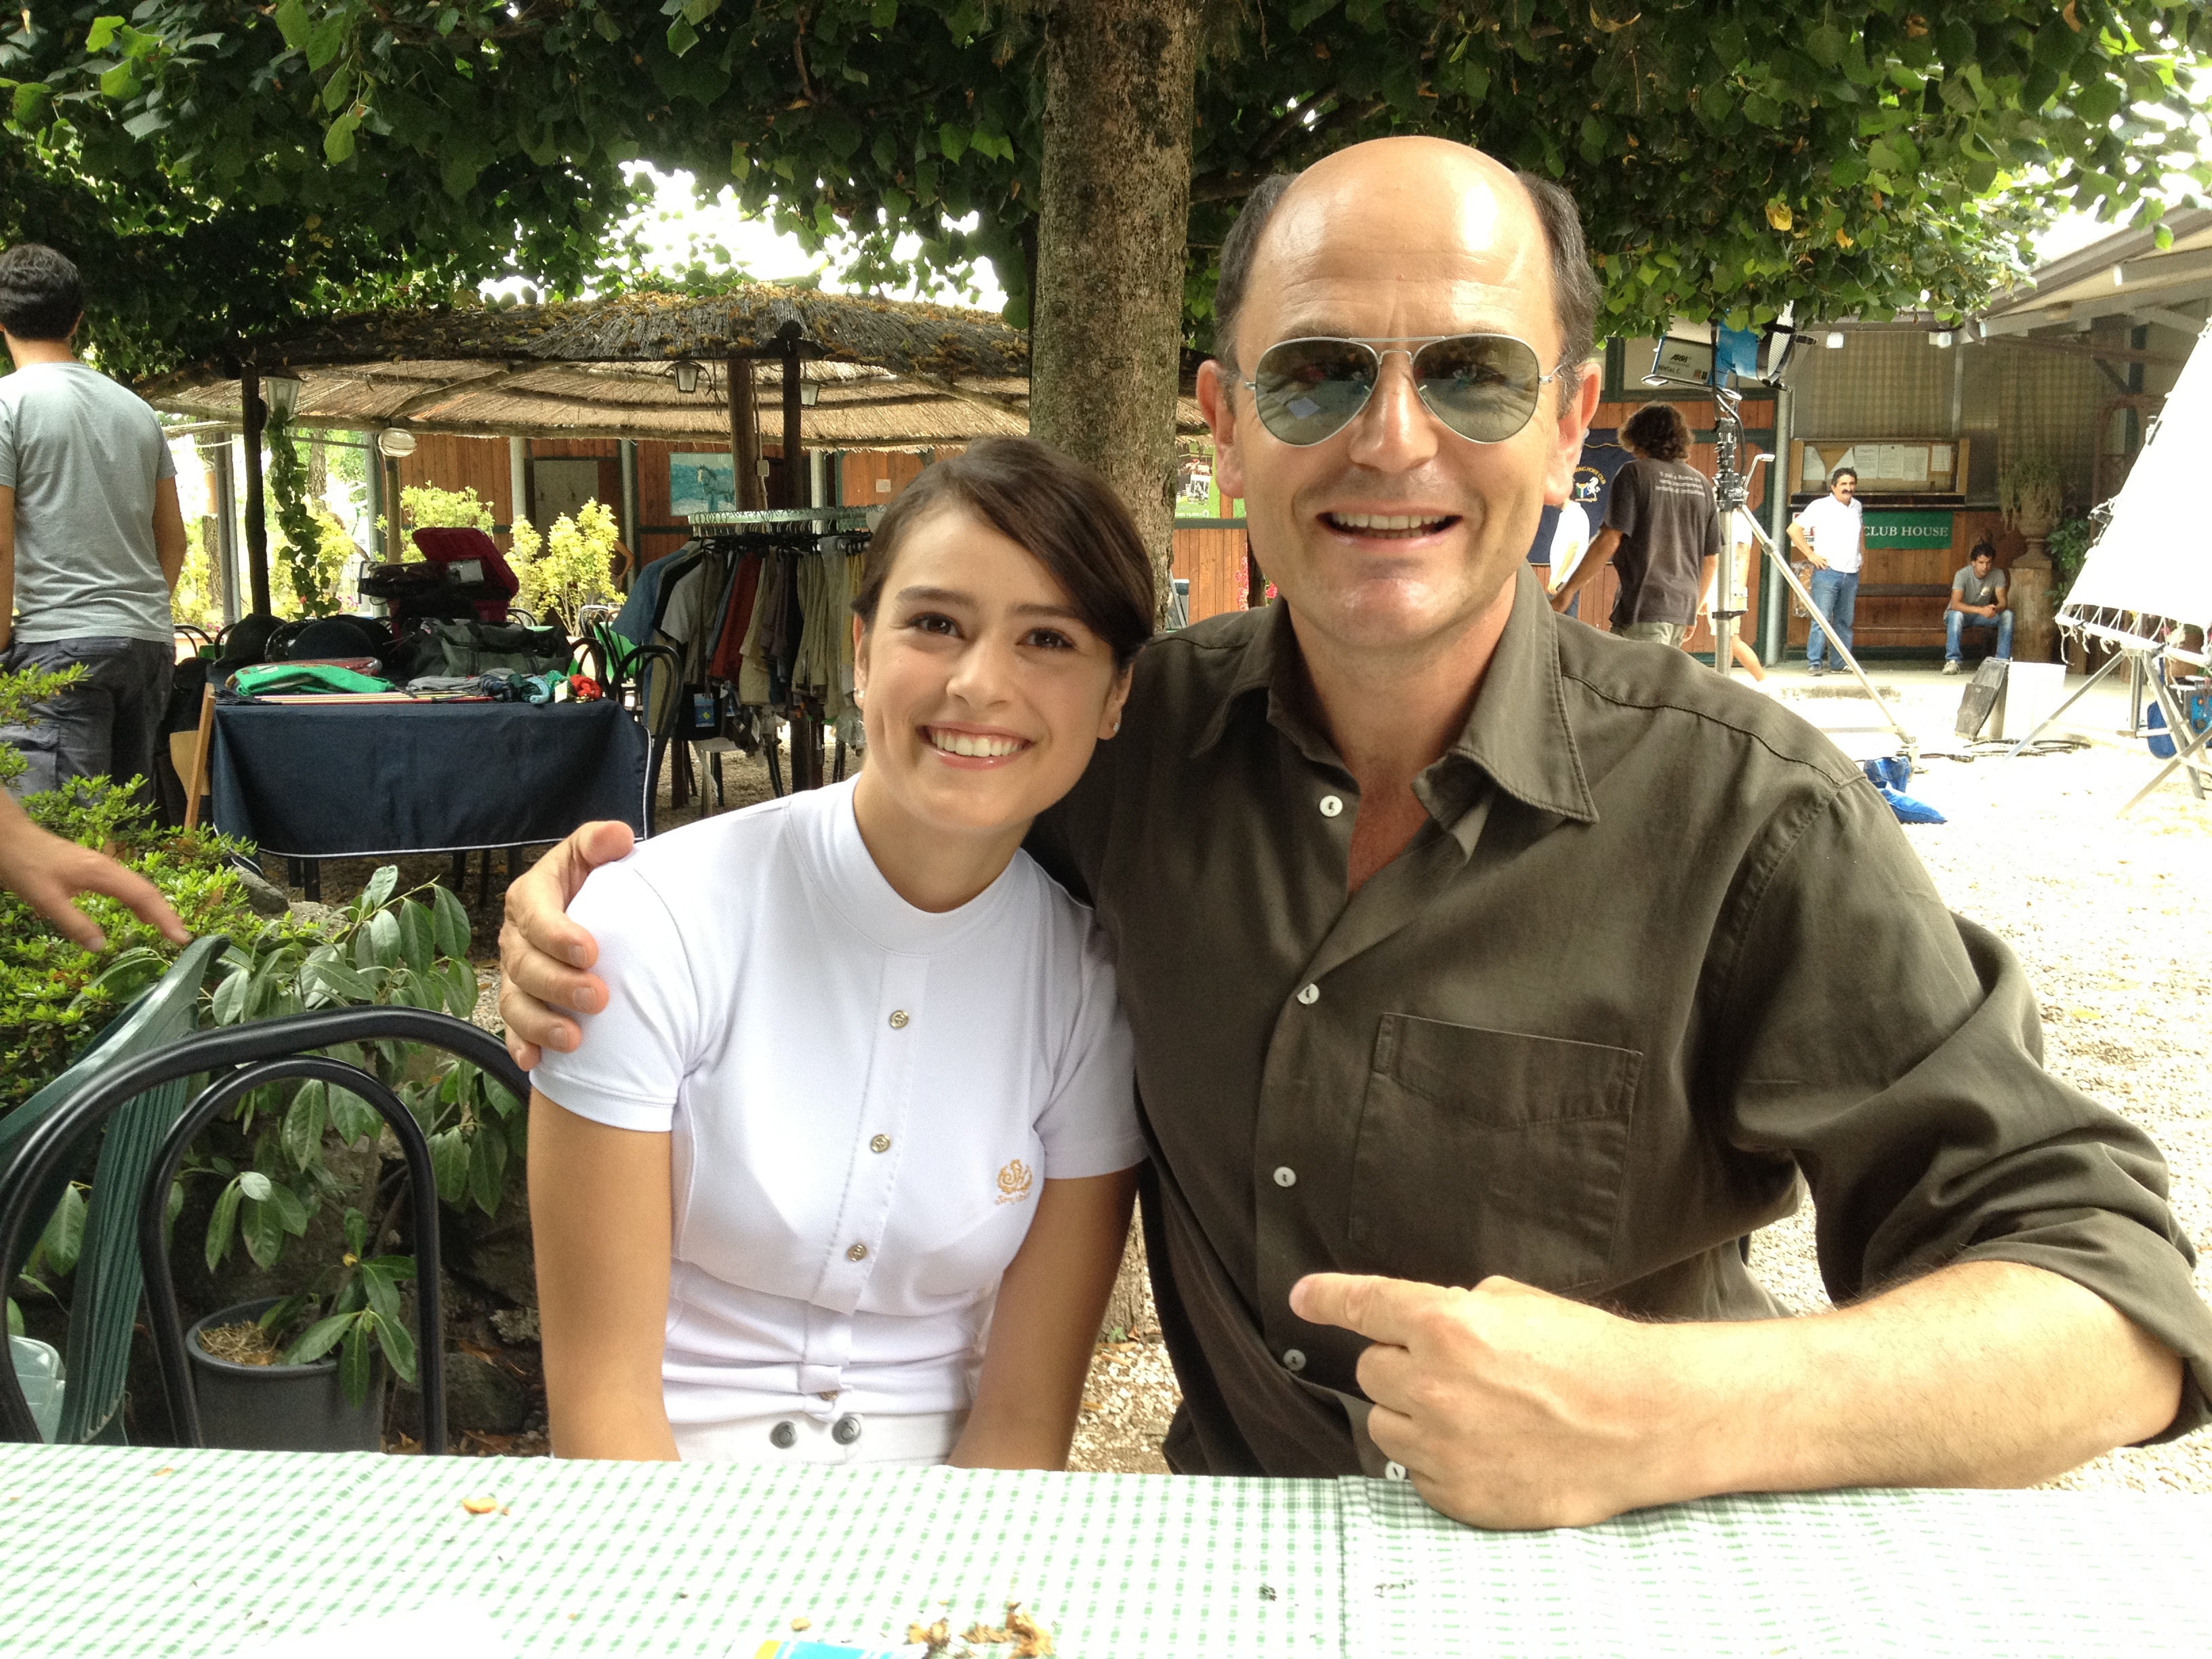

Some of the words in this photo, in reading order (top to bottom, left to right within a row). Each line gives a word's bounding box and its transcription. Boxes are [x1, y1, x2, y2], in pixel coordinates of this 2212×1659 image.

[1670, 354, 1688, 363] ARRI
[1586, 466, 1600, 476] HORSE
[1597, 473, 1606, 485] CLUB
[1864, 526, 1898, 536] CLUB
[1901, 526, 1948, 537] HOUSE
